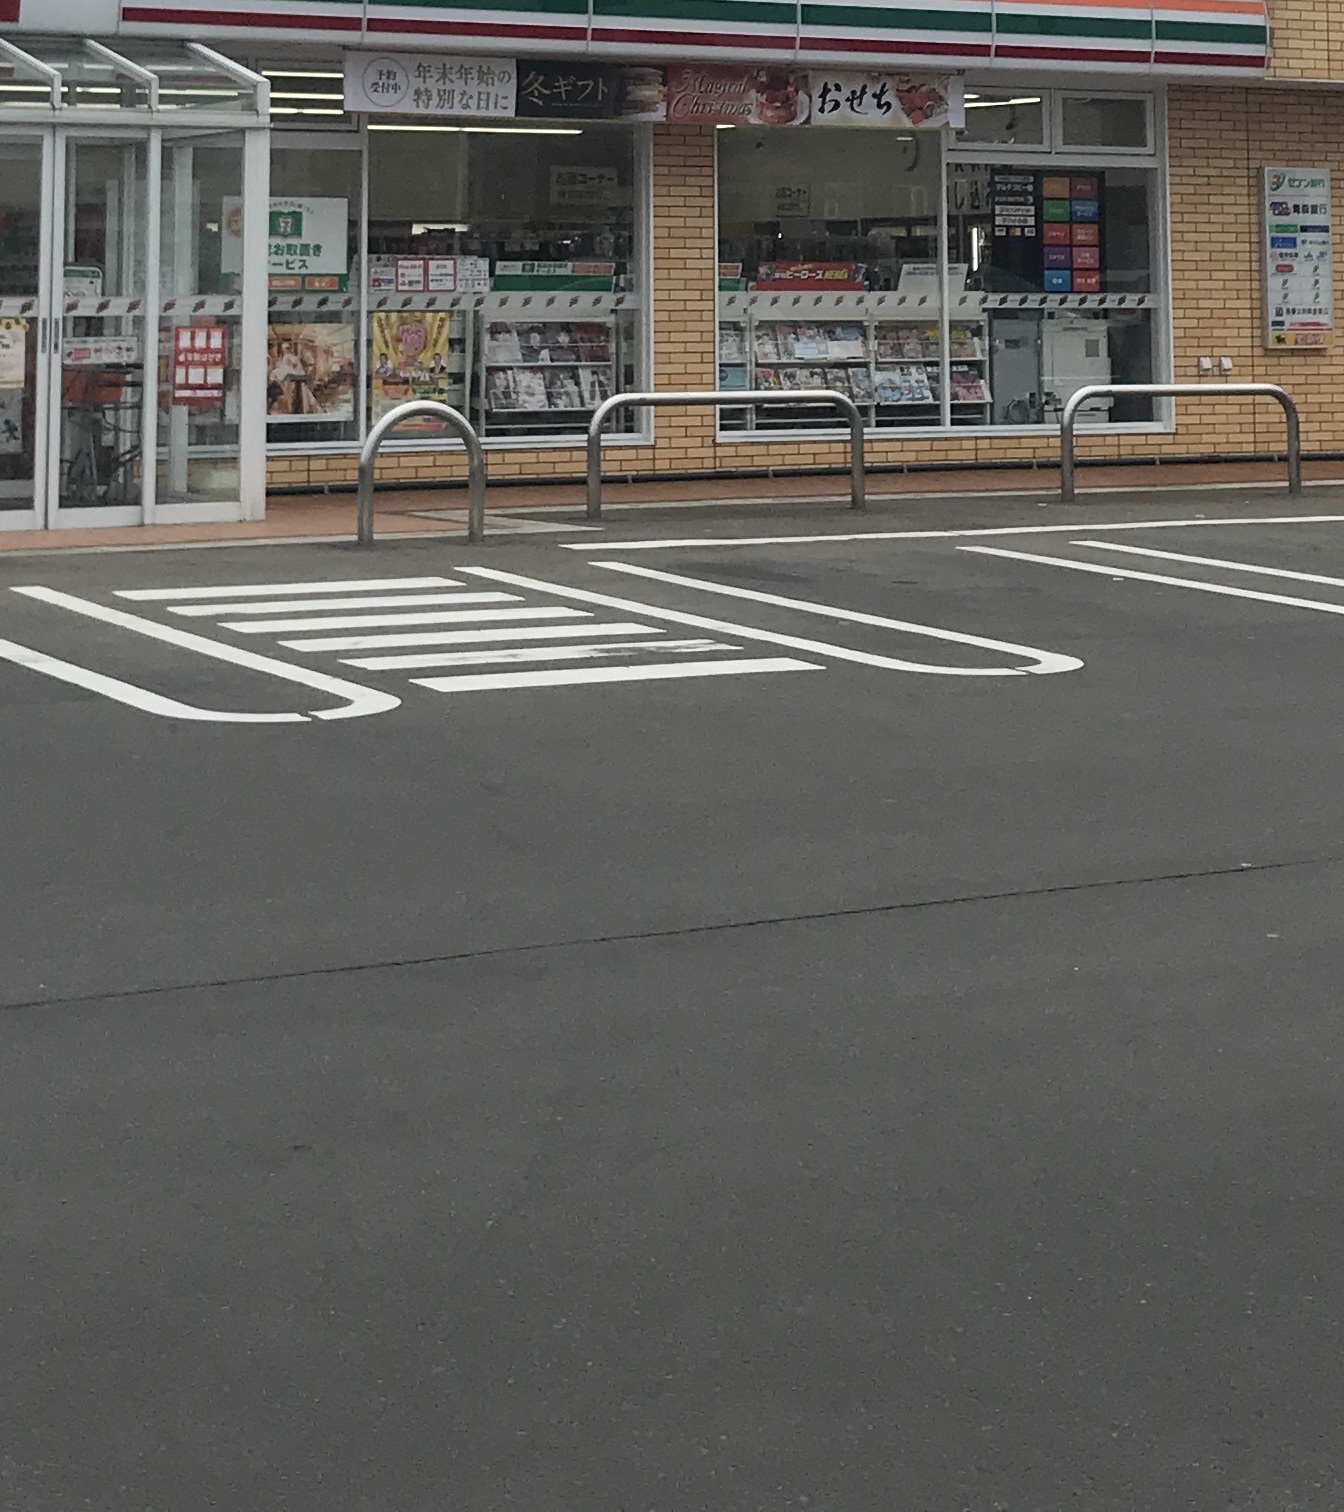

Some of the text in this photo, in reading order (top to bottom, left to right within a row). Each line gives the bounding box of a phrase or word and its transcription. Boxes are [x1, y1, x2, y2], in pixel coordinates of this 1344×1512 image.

[377, 68, 397, 81] 予約
[413, 62, 512, 87] 年末年始の
[674, 68, 749, 96] Magical
[370, 82, 401, 95] 受付中
[413, 87, 509, 111] 特別な日に
[521, 71, 609, 106] 冬ギフト
[818, 81, 893, 116] おせち
[671, 93, 754, 120] Christmas
[268, 259, 309, 270] ービス
